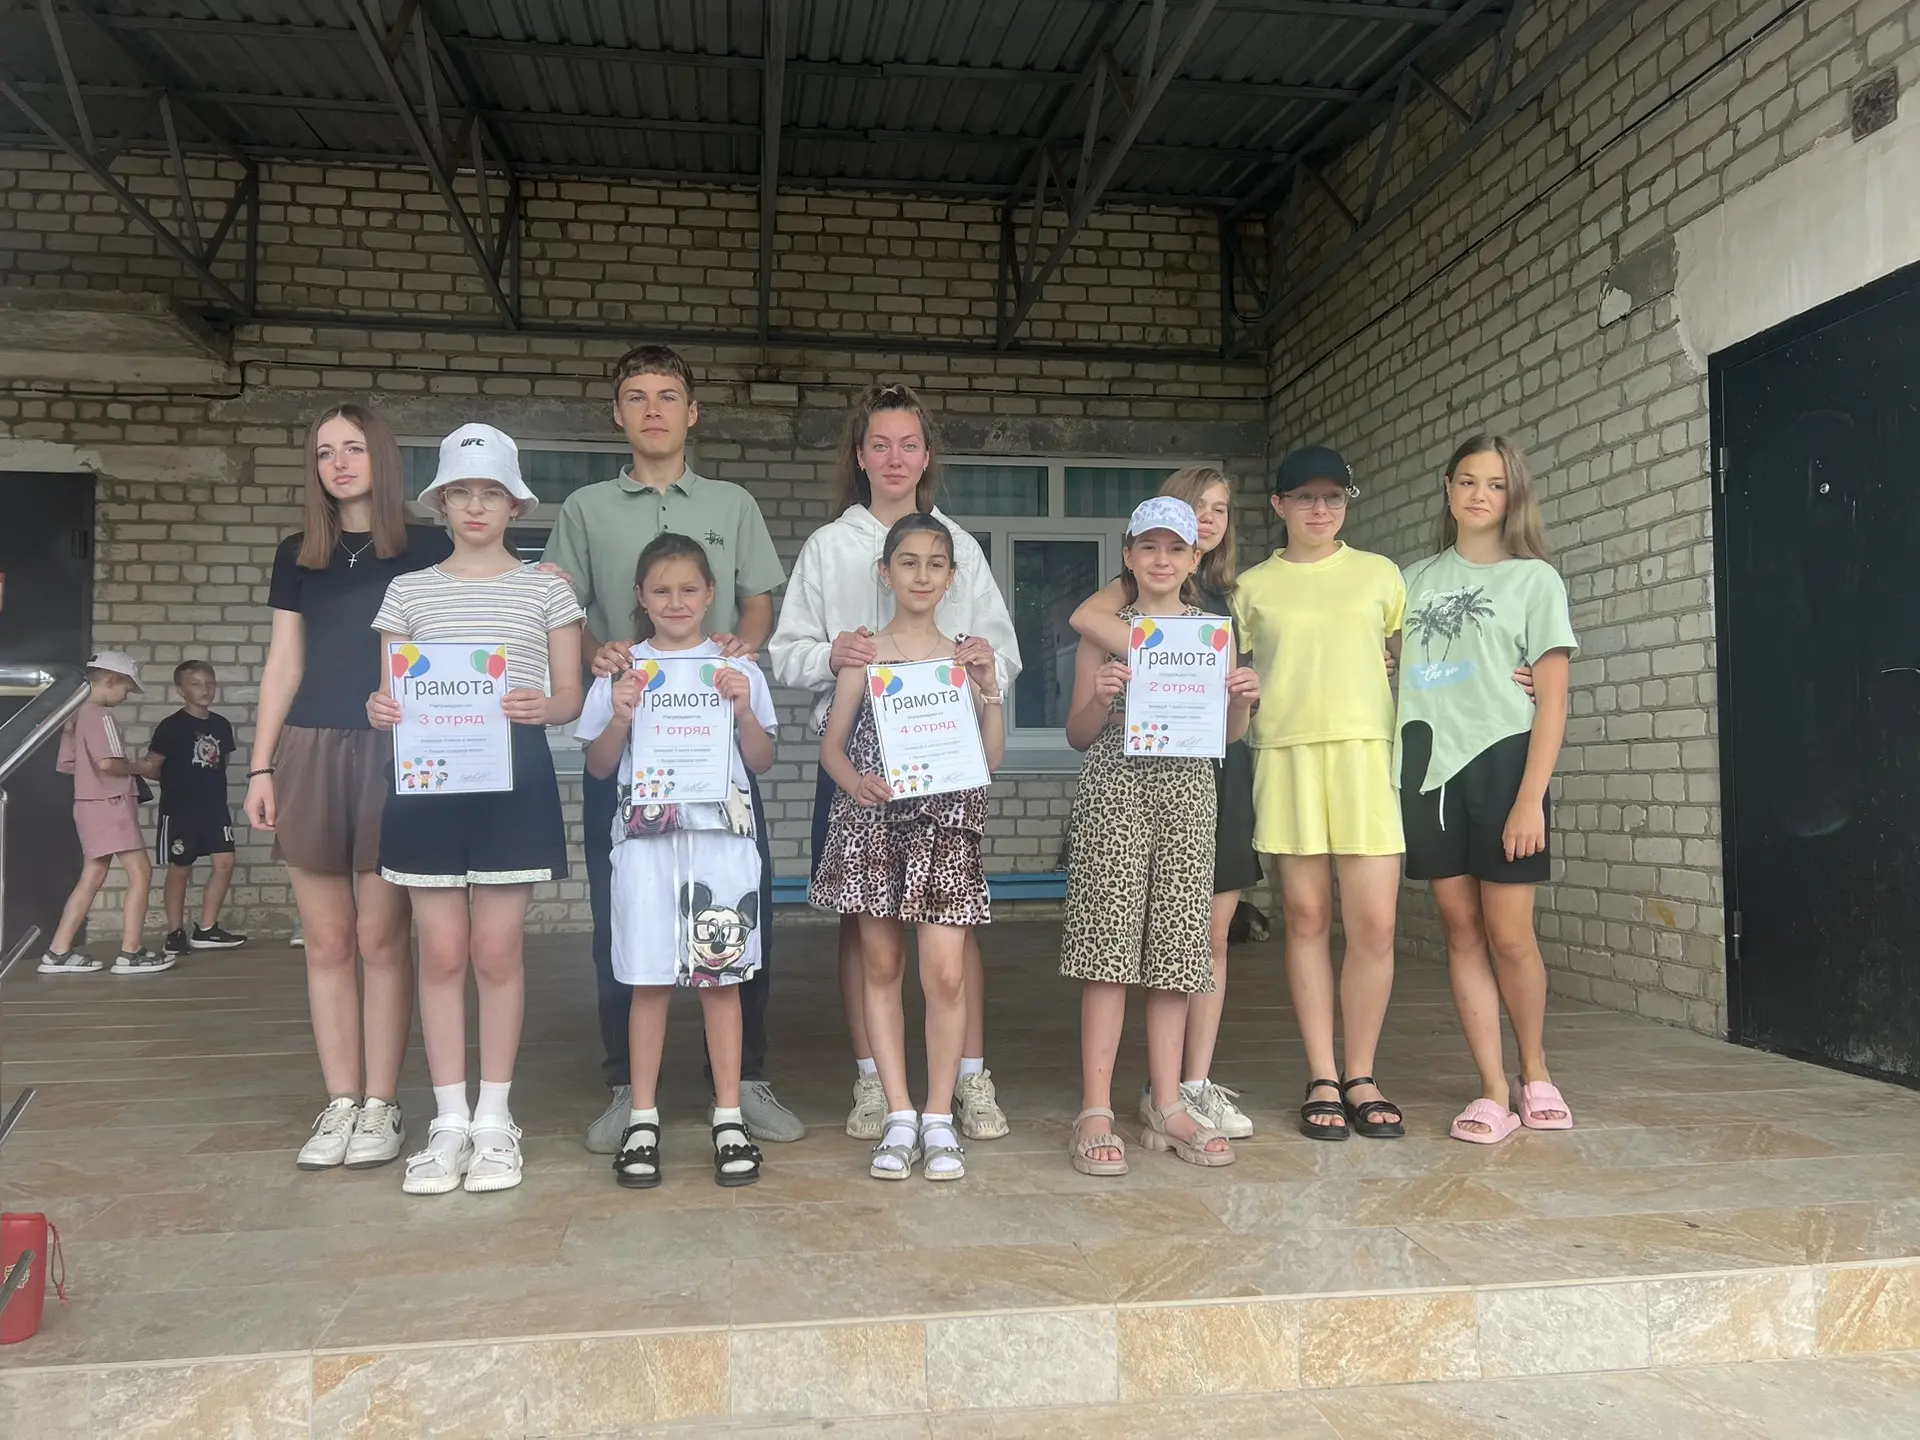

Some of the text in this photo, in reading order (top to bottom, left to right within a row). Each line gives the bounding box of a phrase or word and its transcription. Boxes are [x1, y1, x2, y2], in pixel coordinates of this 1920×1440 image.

[460, 437, 485, 447] UFC
[1139, 647, 1216, 670] Грамота
[403, 675, 494, 701] Грамота
[1149, 681, 1206, 695] 2 отряд
[643, 690, 720, 712] Грамота
[882, 689, 960, 715] Грамота
[419, 713, 485, 727] 3 отряд
[900, 720, 957, 735] 4 отряд
[655, 724, 711, 738] 1 отряд
